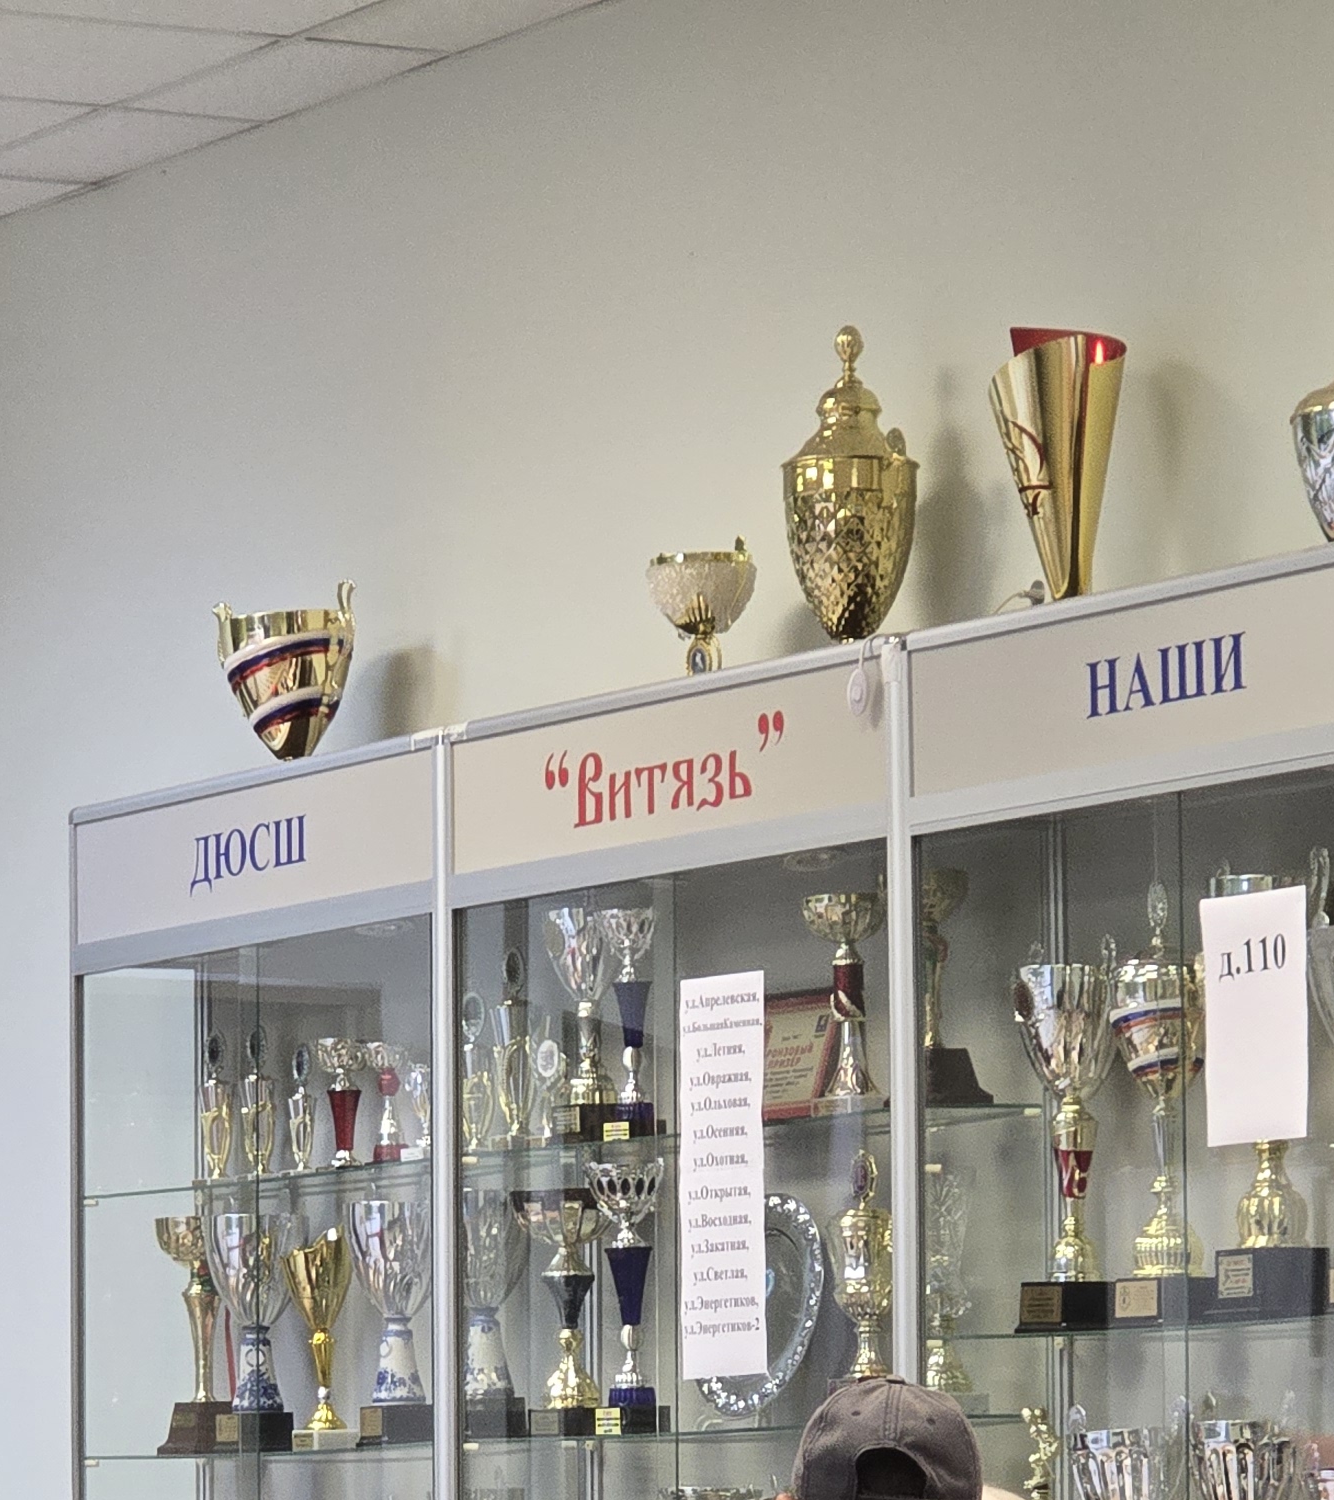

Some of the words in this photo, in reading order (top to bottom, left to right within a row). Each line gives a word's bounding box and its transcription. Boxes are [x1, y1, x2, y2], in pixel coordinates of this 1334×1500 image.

[189, 815, 307, 896] ДЮСШ
[1085, 632, 1247, 719] НАШИ
[1218, 933, 1287, 982] д.110
